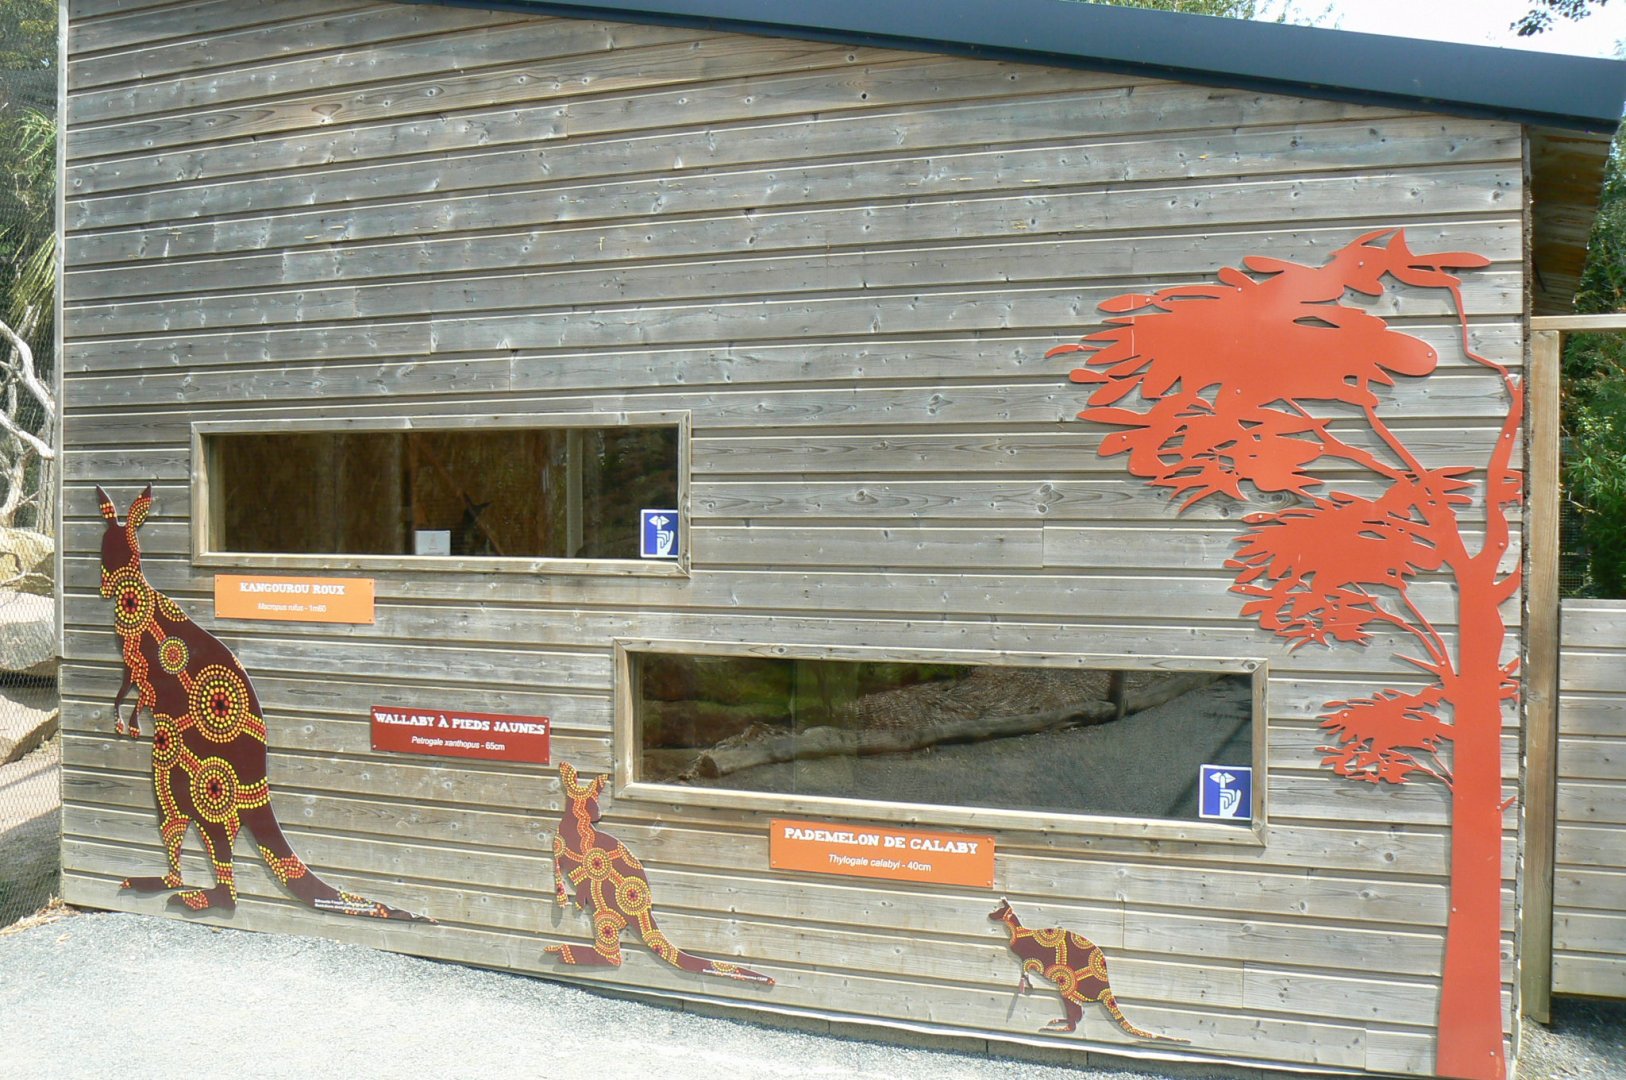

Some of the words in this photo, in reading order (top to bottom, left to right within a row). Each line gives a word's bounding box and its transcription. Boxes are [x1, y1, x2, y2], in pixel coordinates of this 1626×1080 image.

[240, 582, 309, 594] KANGOUROU
[313, 584, 345, 595] ROUX
[374, 713, 435, 727] WALLABY
[438, 714, 450, 728] À
[452, 718, 490, 731] PIEDS
[493, 721, 546, 735] JAUNES
[411, 735, 443, 747] Petrogale
[444, 739, 480, 750] xanthopus
[485, 741, 506, 751] 65cm
[784, 827, 880, 847] PADEMELON
[884, 836, 906, 849] DE
[910, 838, 979, 854] CALABY
[828, 854, 869, 867] Thylogale
[907, 861, 932, 872] 40cm
